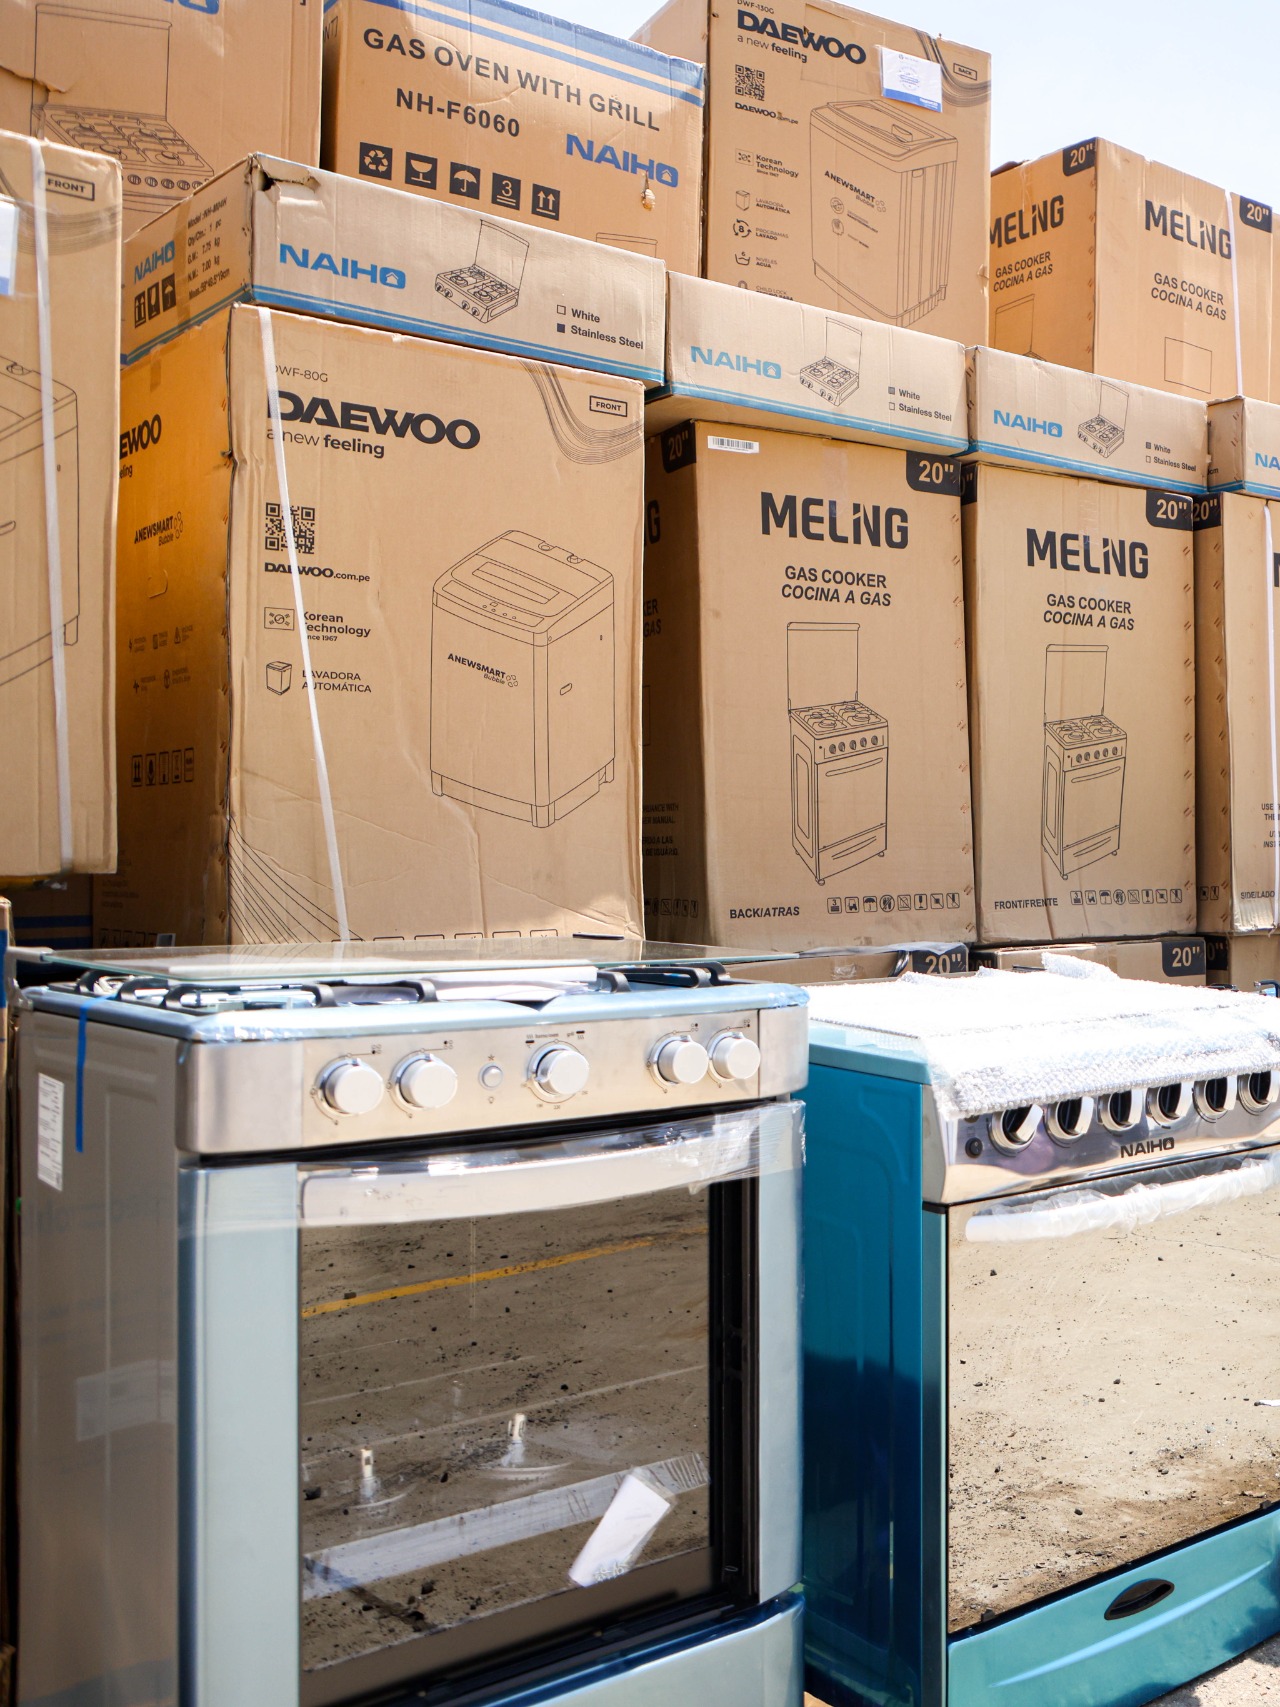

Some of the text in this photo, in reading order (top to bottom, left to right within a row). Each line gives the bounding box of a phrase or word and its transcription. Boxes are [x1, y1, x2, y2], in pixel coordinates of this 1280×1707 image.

[737, 9, 867, 64] DAEWOO
[737, 35, 807, 63] a new feeling
[363, 28, 426, 60] GAS
[434, 46, 509, 83] OVEN
[517, 69, 582, 106] WITH
[589, 92, 660, 131] GRILL
[396, 88, 520, 138] NH-F6060
[566, 133, 679, 188] NAIHO
[756, 154, 783, 166] Korean
[1070, 142, 1093, 168] 20"
[756, 161, 799, 178] Technology
[47, 178, 86, 193] FRONT
[1246, 203, 1269, 223] 20"
[1145, 199, 1231, 259] MELING
[134, 240, 175, 285] NAIHO
[280, 243, 406, 289] NAIHO
[995, 251, 1051, 279] GAS COOKER
[993, 264, 1053, 293] COCINA A GAS
[1154, 272, 1224, 305] GAS COOKER
[571, 308, 600, 323] White
[1151, 287, 1227, 320] COCINA A GAS
[570, 325, 644, 350] Stainless Steel
[690, 345, 782, 379] NAIHO
[899, 388, 921, 400] White
[595, 402, 622, 412] FRONT
[899, 403, 952, 422] Stainless Steel
[268, 389, 481, 450] DAEWOO
[994, 409, 1063, 438] NAIHO
[120, 414, 162, 460] EWOO
[282, 429, 385, 459] new feeling
[1154, 443, 1171, 454] White
[918, 460, 954, 484] 20"
[1153, 455, 1197, 472] Stainless Steel
[761, 491, 909, 550] MELING
[1156, 499, 1187, 520] 20"
[134, 516, 173, 544] ANEWSMART
[1026, 528, 1149, 579] MELING
[784, 565, 887, 588] GAS COOKER
[781, 583, 892, 607] COCINA A GAS
[1046, 593, 1131, 614] GAS COOKER
[302, 611, 344, 623] Korean
[1043, 610, 1135, 631] COCINA A GAS
[304, 622, 371, 638] echnology
[321, 634, 338, 642] 1967
[447, 653, 506, 679] ANEWSMART
[729, 906, 800, 920] BACK/ATRAS
[994, 897, 1058, 910] FRONT/FRENTE
[925, 952, 961, 974] 20"
[1172, 946, 1201, 968] 20"
[1120, 1136, 1175, 1159] NAIHO
